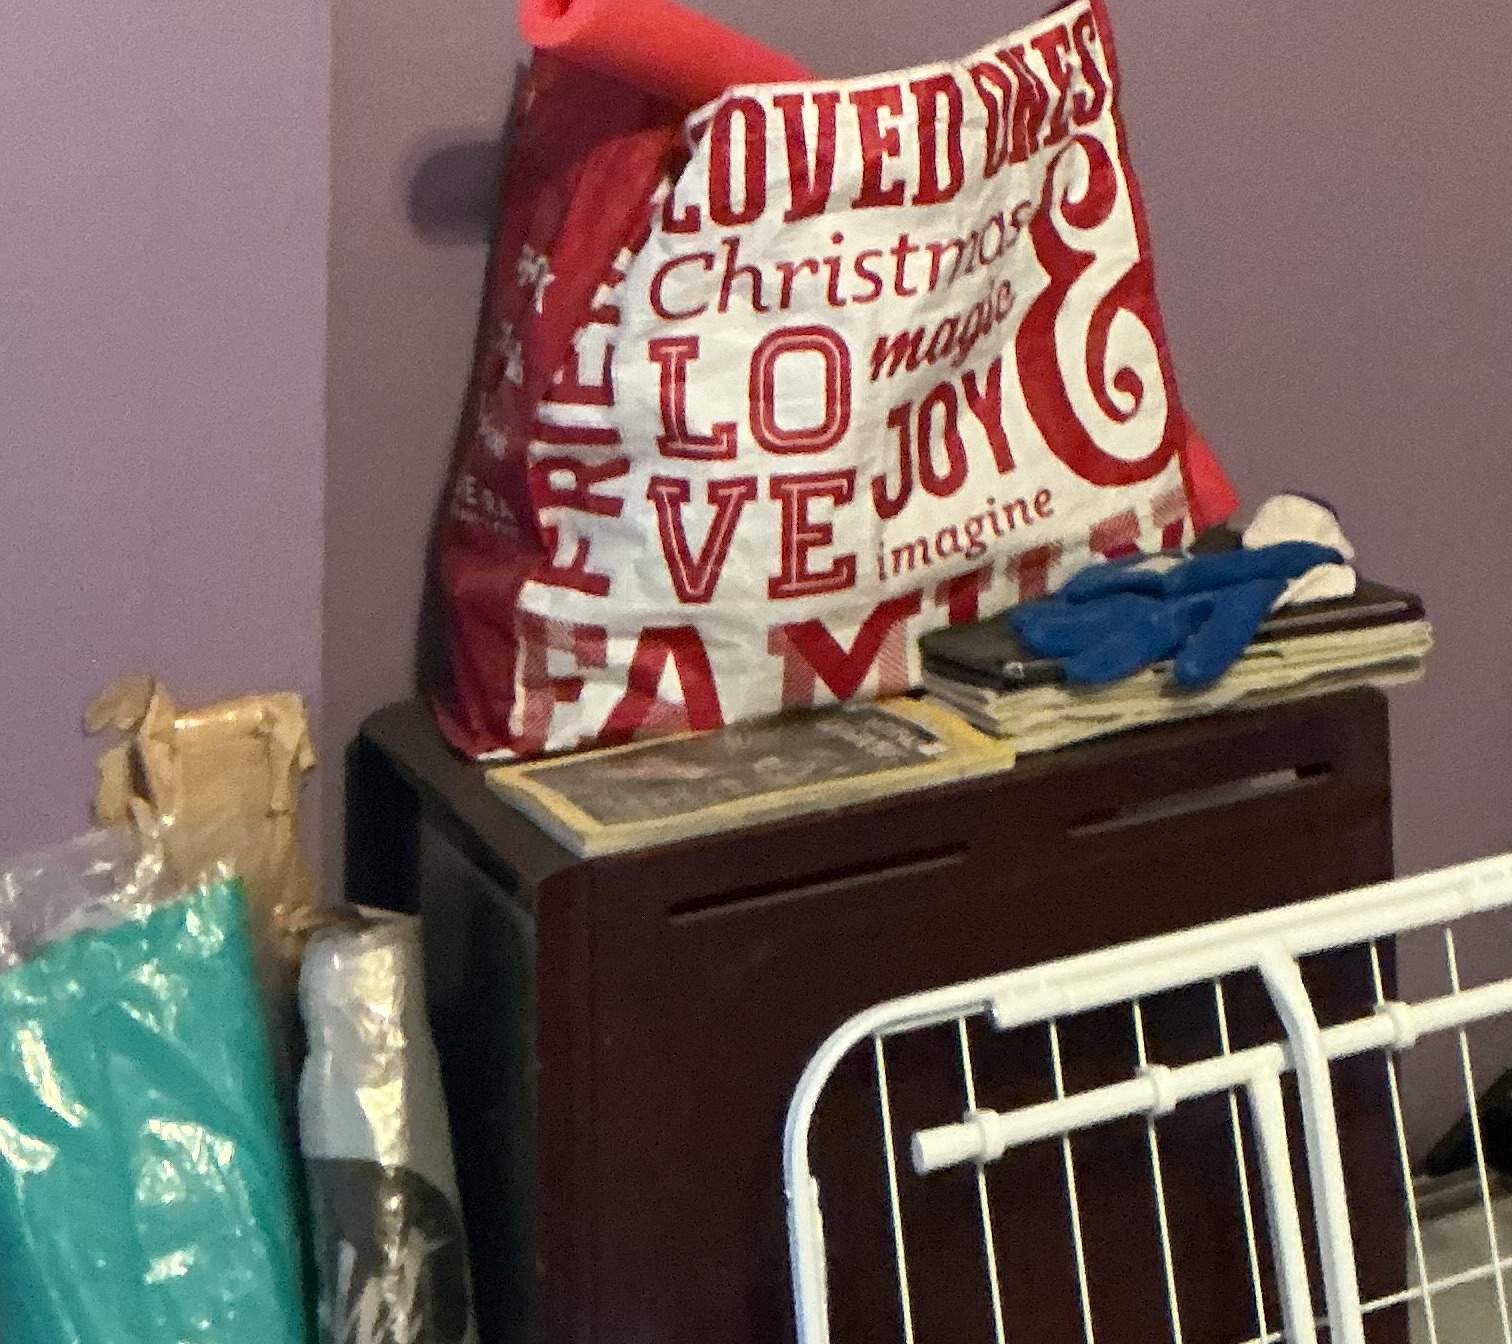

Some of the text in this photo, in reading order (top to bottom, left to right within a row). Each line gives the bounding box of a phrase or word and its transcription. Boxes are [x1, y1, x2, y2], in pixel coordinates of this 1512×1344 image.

[970, 13, 1107, 178] ONES
[649, 199, 1033, 323] Christmas
[1014, 134, 1181, 487] &
[872, 355, 1016, 519] JOY
[876, 487, 1055, 582] imagine
